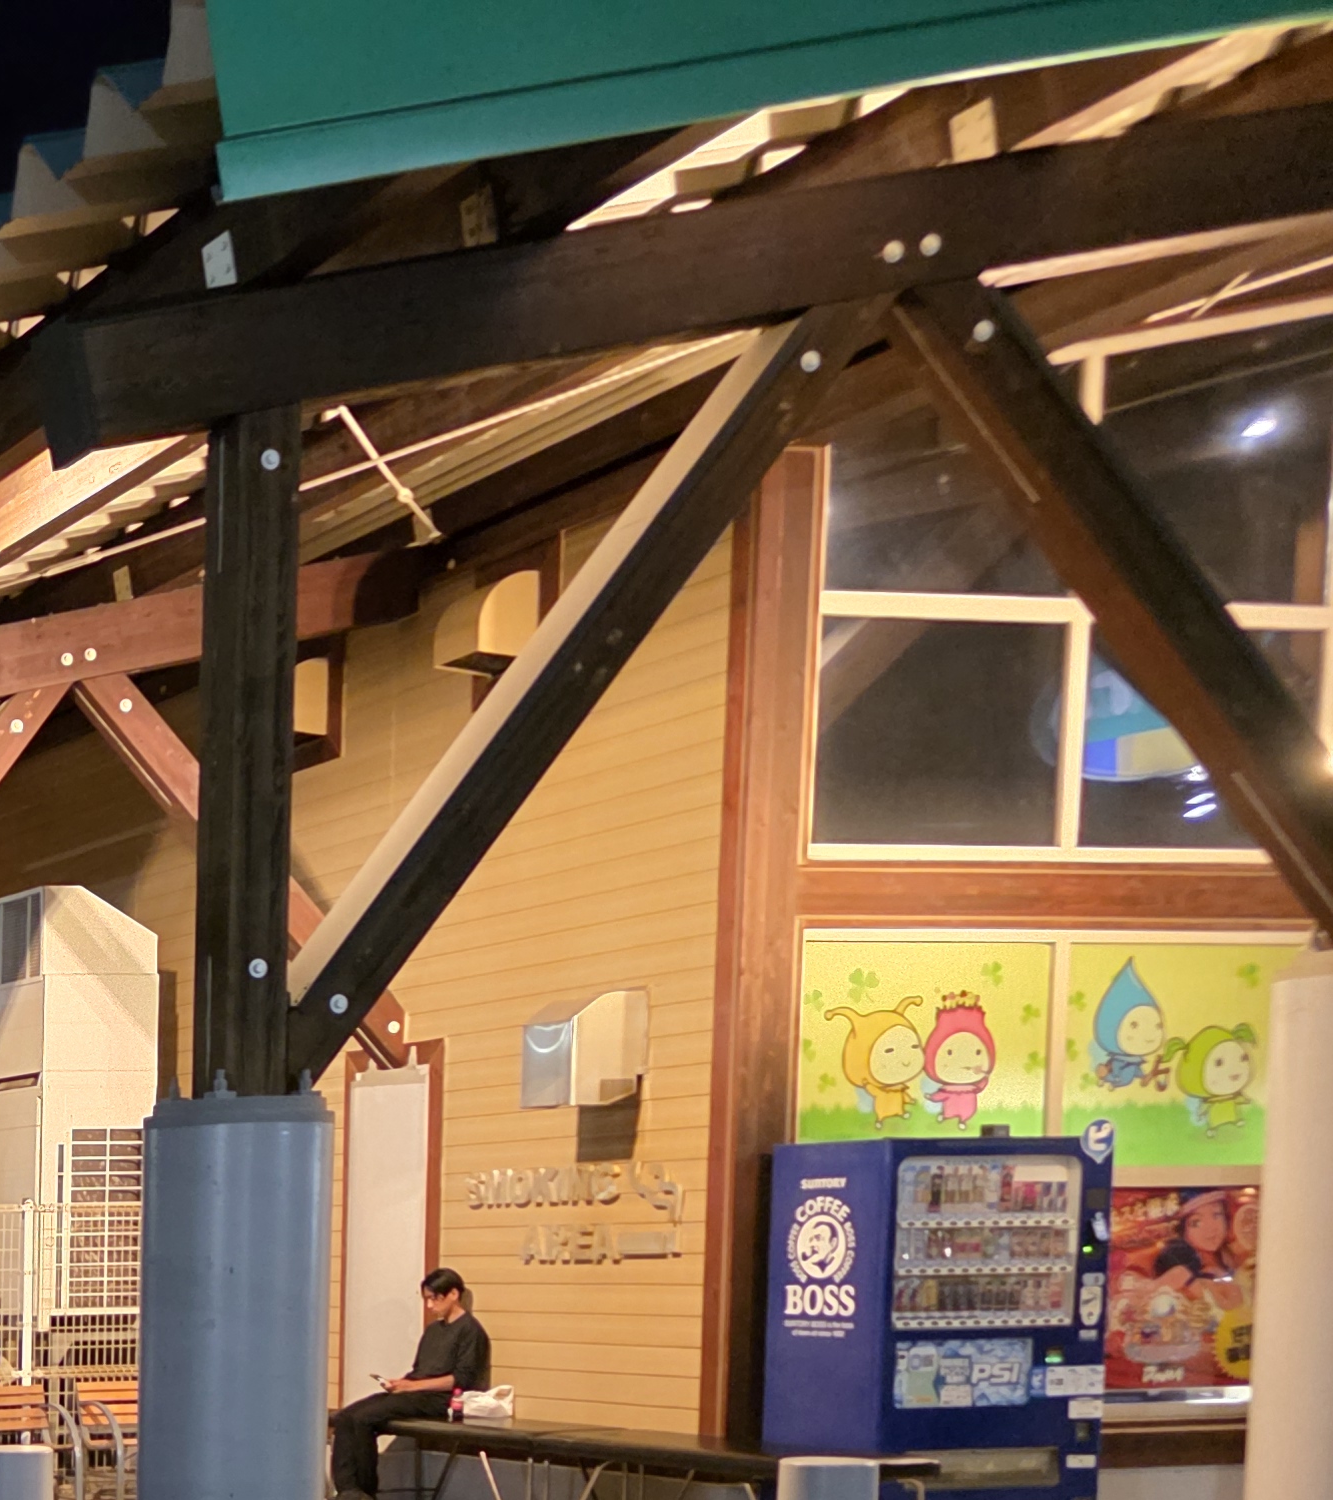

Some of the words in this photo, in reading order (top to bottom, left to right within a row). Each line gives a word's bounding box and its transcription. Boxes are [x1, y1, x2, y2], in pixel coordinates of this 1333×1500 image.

[465, 1164, 621, 1209] SMOKING
[795, 1196, 851, 1222] COFFEE
[522, 1222, 621, 1265] AREA
[784, 1284, 856, 1316] BOSS
[970, 1361, 1021, 1385] PSI
